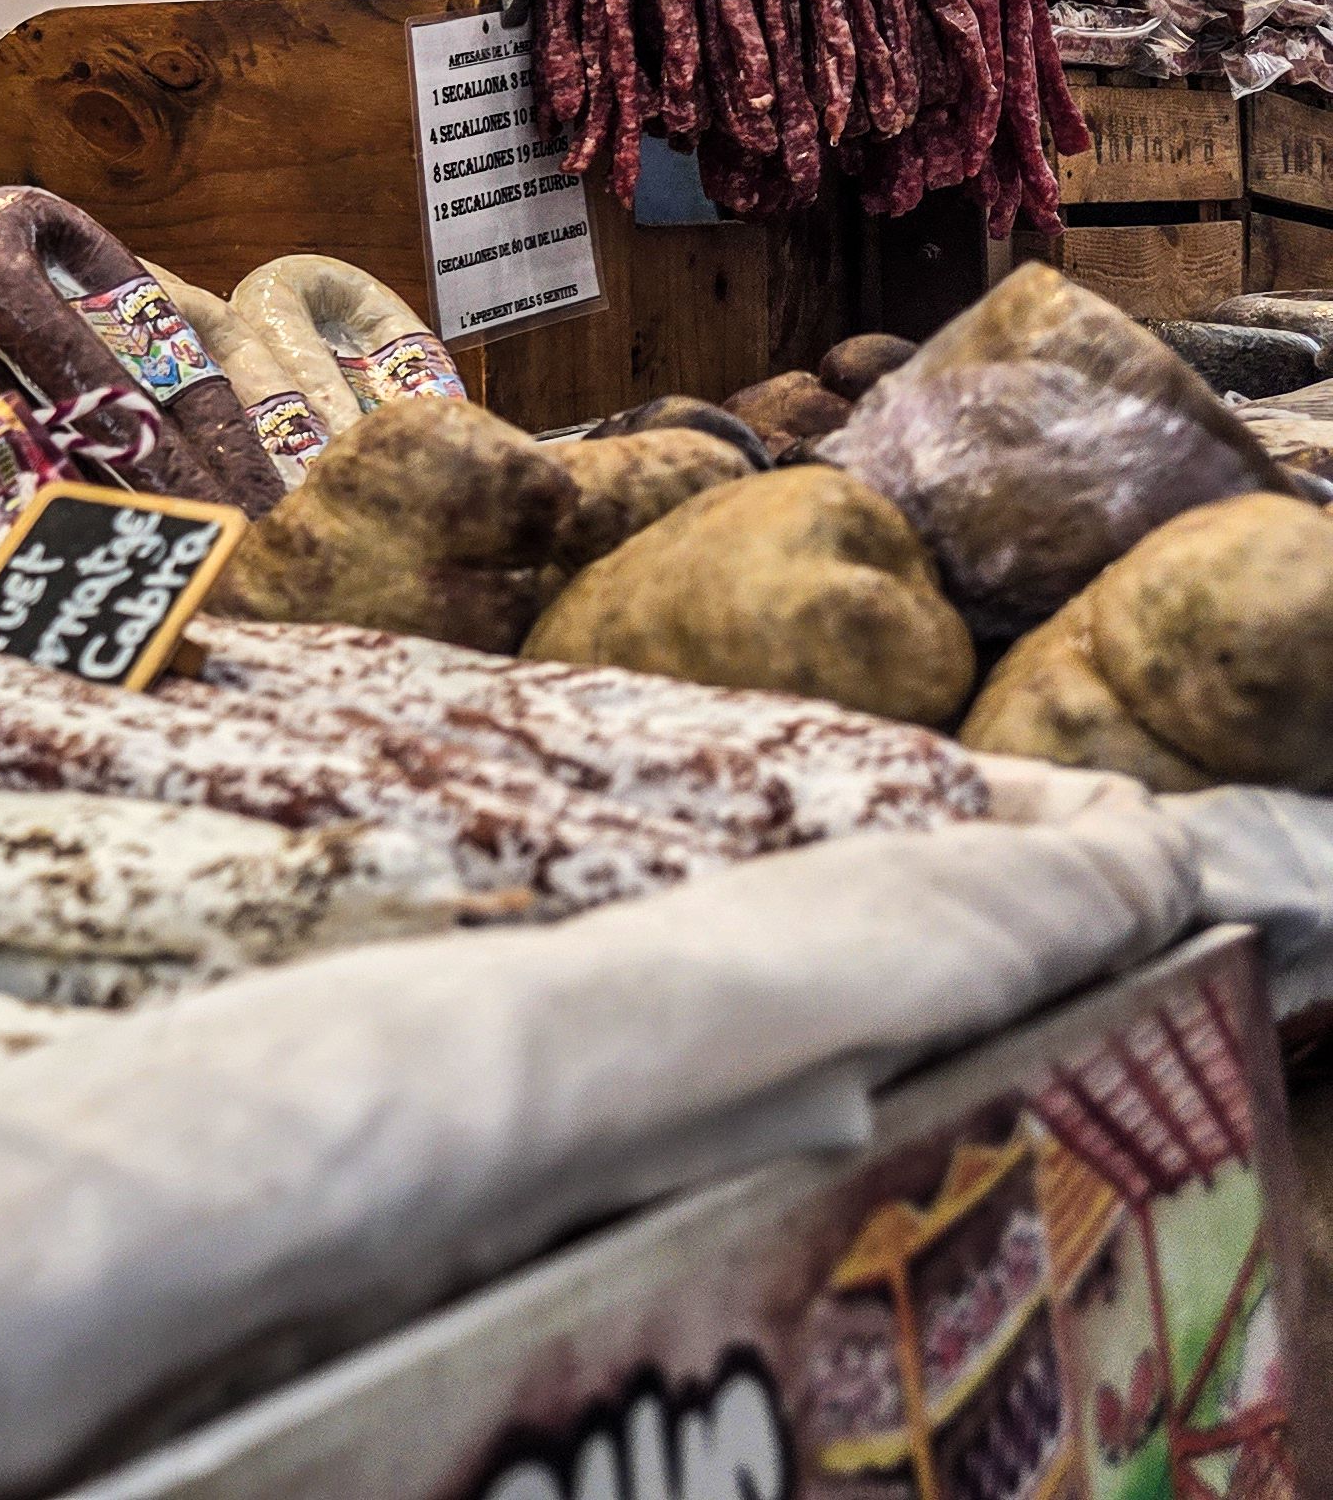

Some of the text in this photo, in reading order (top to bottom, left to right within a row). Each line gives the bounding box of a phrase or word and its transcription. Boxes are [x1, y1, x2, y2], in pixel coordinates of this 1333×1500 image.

[432, 89, 439, 106] 1
[442, 75, 509, 105] SECALLONA
[430, 128, 438, 145] 4
[440, 111, 511, 144] SECALLONES
[513, 108, 529, 128] 10
[433, 135, 569, 184] 8 SECALLONES 19 EUROS
[434, 174, 579, 221] 12 SECALLONES 25 EUROS
[499, 242, 511, 258] DE
[538, 232, 550, 247] DE
